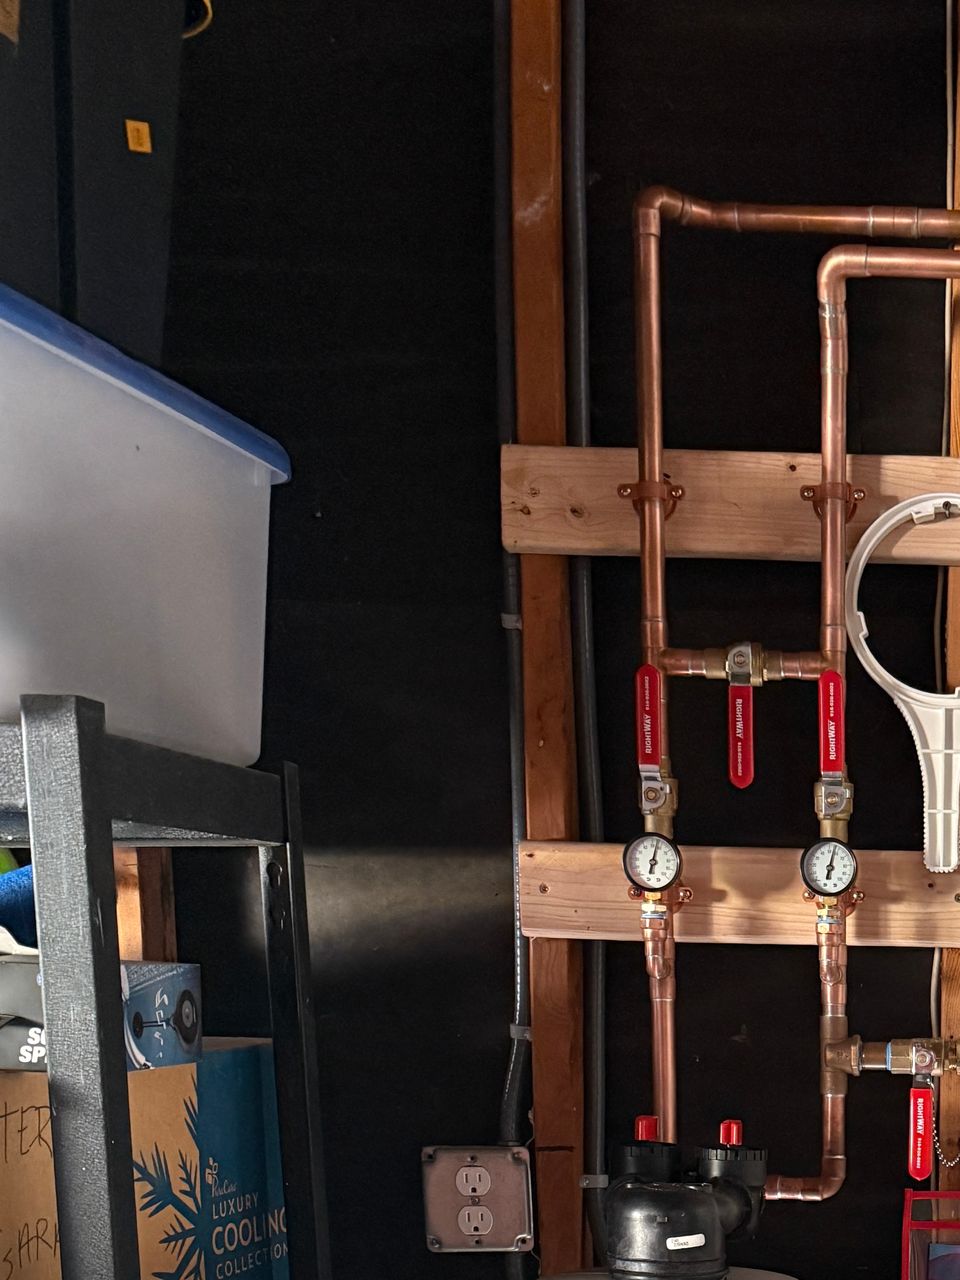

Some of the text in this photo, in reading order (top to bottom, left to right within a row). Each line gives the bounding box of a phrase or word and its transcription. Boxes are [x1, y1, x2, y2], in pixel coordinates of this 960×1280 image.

[643, 713, 652, 754] RIGHTWAY
[736, 698, 744, 739] RIGHTWAY
[828, 719, 836, 760] RIGHTWAY
[27, 1027, 47, 1046] S
[212, 1192, 259, 1220] LUXURY
